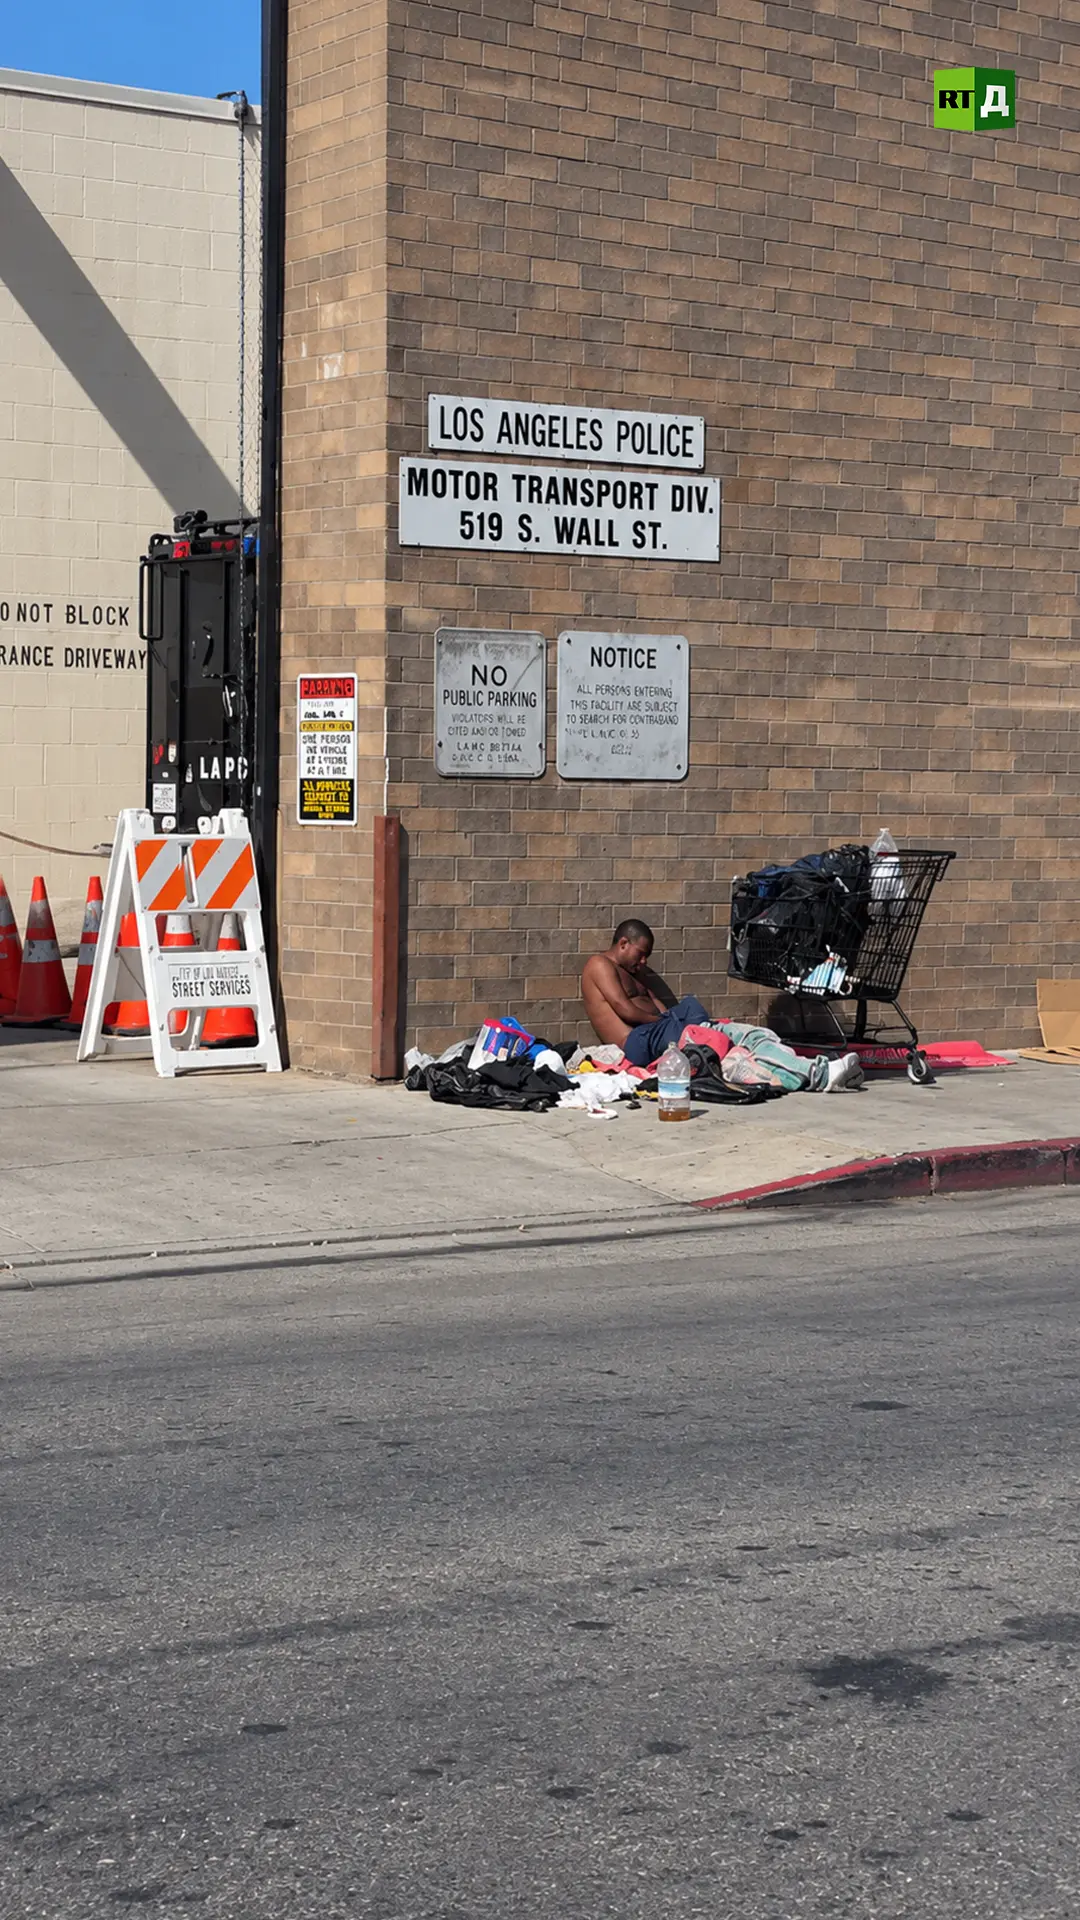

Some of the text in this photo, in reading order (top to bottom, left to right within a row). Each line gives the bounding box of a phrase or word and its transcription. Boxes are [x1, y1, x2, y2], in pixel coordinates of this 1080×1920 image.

[439, 405, 694, 458] LOS ANGELES POLICE
[407, 467, 714, 514] MOTOR TRANSPORT DIV.
[460, 511, 668, 550] 519 S. WALL ST.
[0, 602, 130, 626] O NOT BLOCK
[0, 645, 147, 669] RANCE DRIVEWAY
[590, 646, 657, 669] NOTICE
[472, 664, 507, 687] NO
[443, 689, 537, 708] PUBLIC PARKING
[577, 684, 592, 695] ALL
[566, 714, 576, 724] TO
[613, 714, 627, 724] FOR
[172, 979, 251, 998] STREET SERVICES
